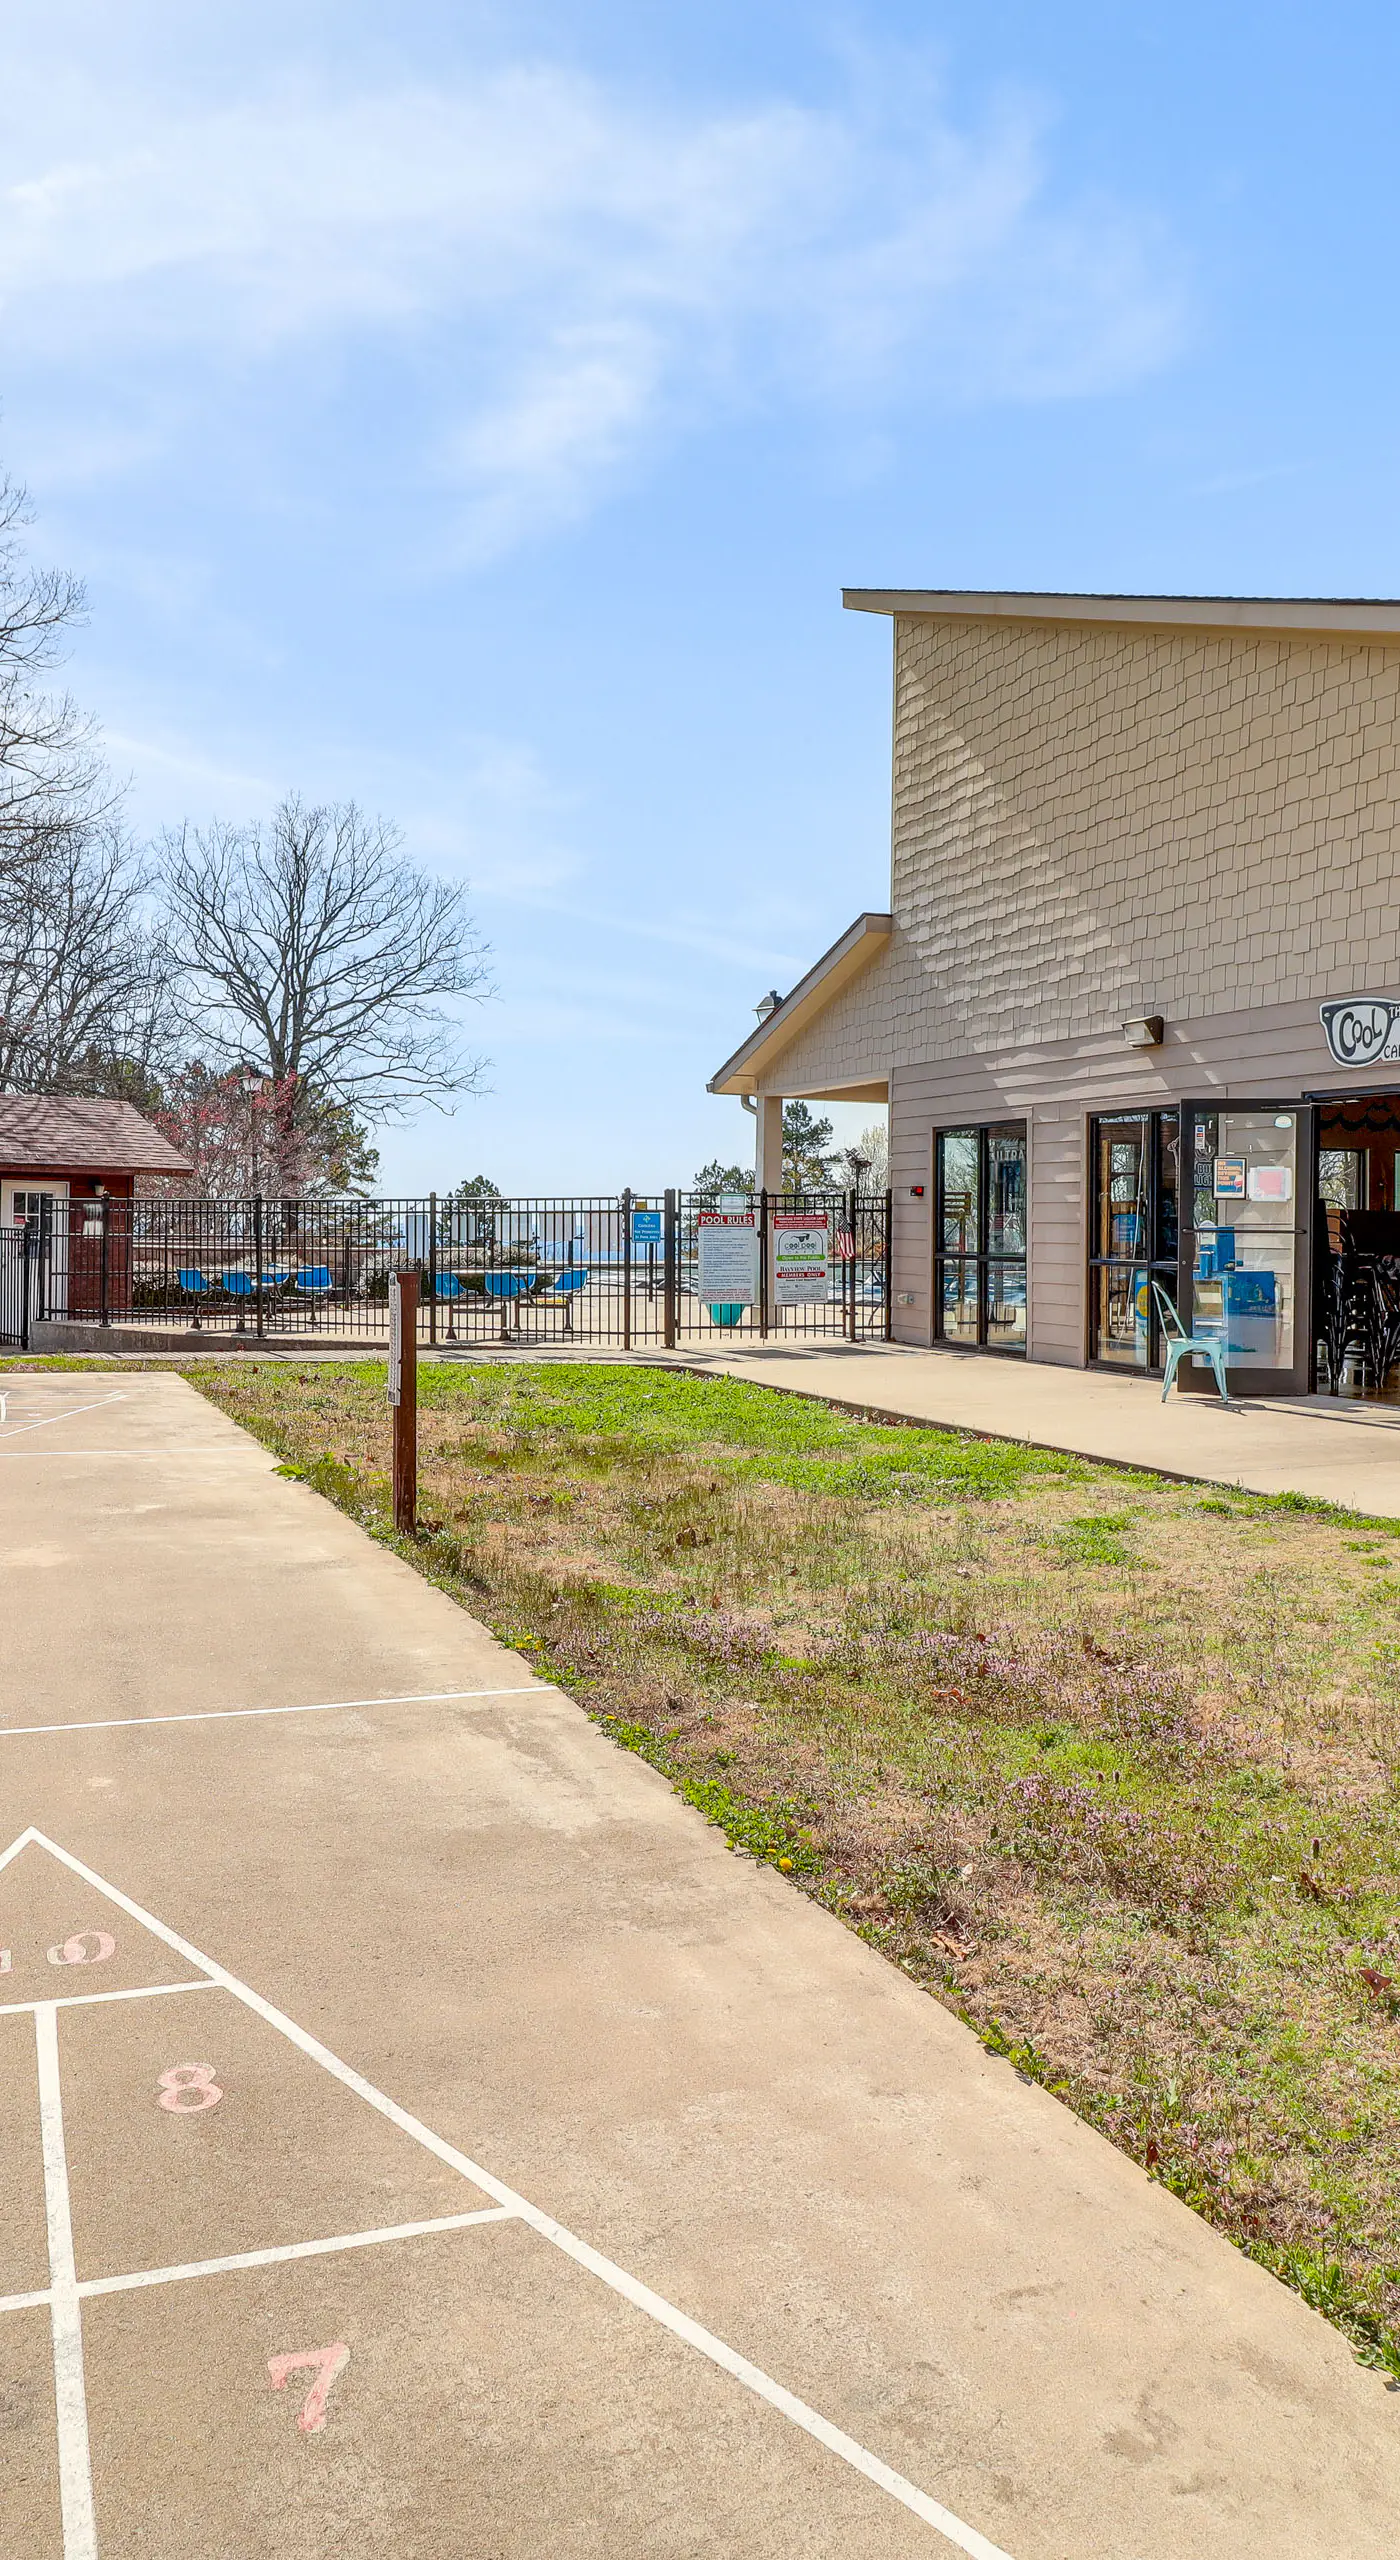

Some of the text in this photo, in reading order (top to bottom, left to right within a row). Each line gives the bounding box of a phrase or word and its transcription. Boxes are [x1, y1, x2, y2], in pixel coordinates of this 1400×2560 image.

[1197, 1163, 1212, 1175] BU
[1194, 1174, 1212, 1187] LIGH
[700, 1215, 753, 1225] POOL RULES
[156, 2061, 224, 2114] 8
[266, 2341, 351, 2433] 7
